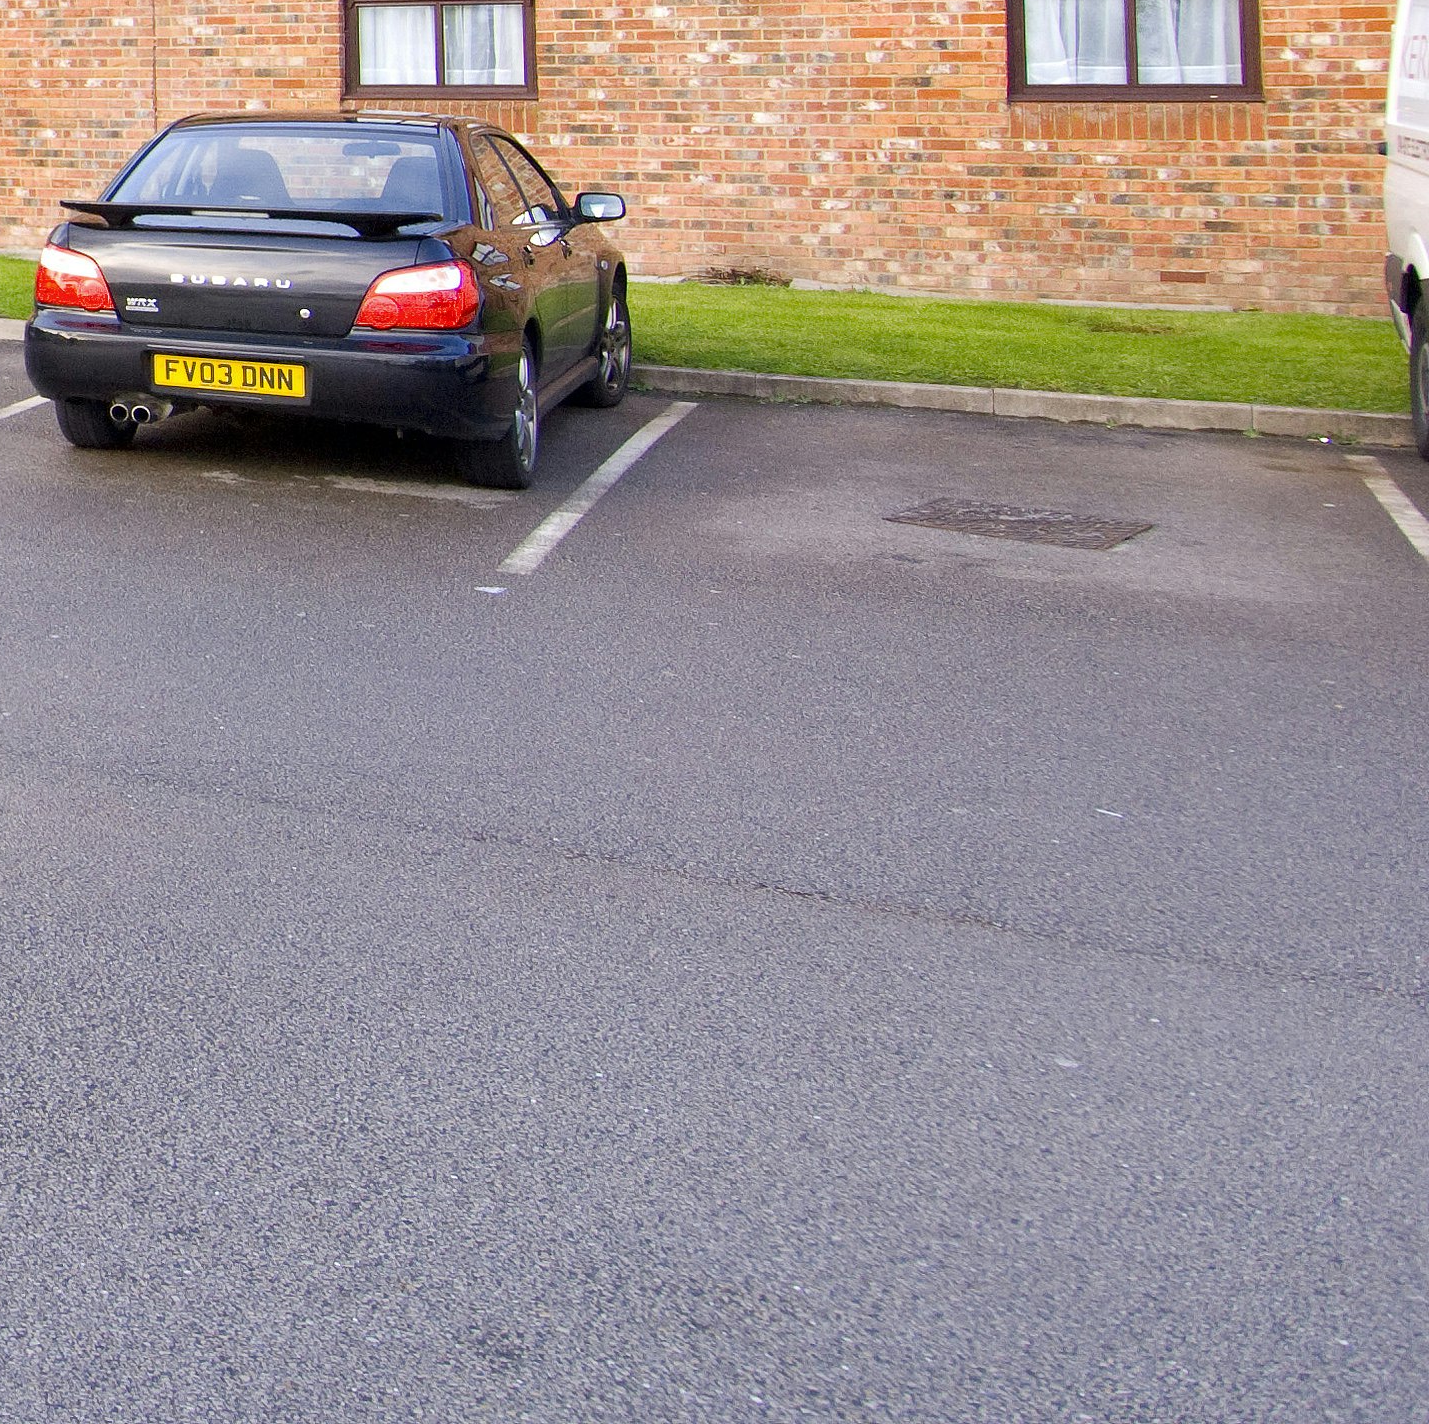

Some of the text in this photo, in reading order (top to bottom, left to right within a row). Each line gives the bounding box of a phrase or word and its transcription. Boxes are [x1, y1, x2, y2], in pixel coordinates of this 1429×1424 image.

[170, 273, 291, 289] SUBARU
[126, 297, 157, 308] WRX
[165, 359, 293, 391] FV03 DNN
